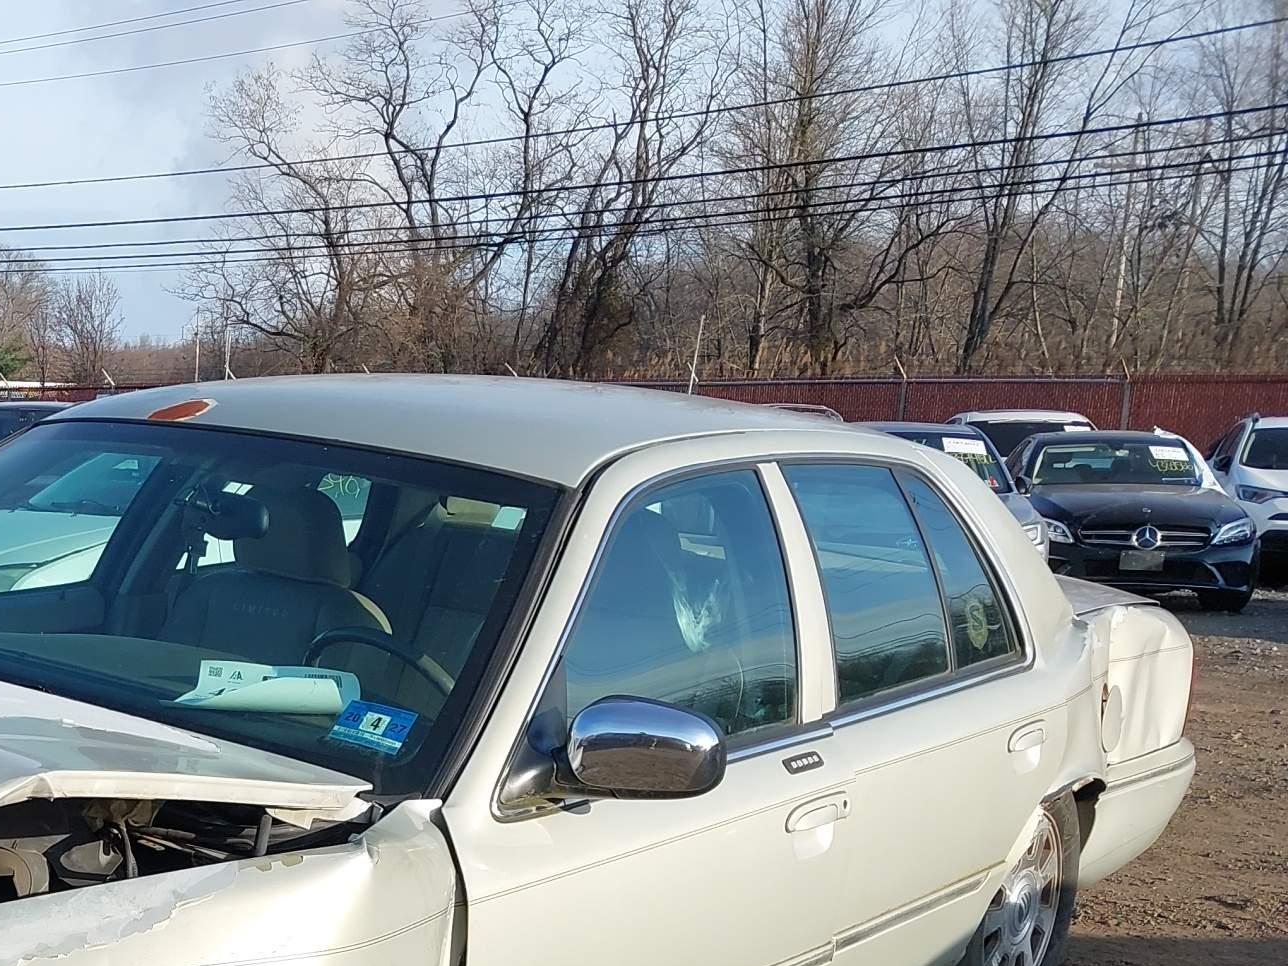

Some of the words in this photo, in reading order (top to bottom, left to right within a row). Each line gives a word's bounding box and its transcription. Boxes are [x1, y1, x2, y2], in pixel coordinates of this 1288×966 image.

[344, 711, 362, 723] 20
[369, 715, 384, 732] 4
[388, 722, 408, 734] 27
